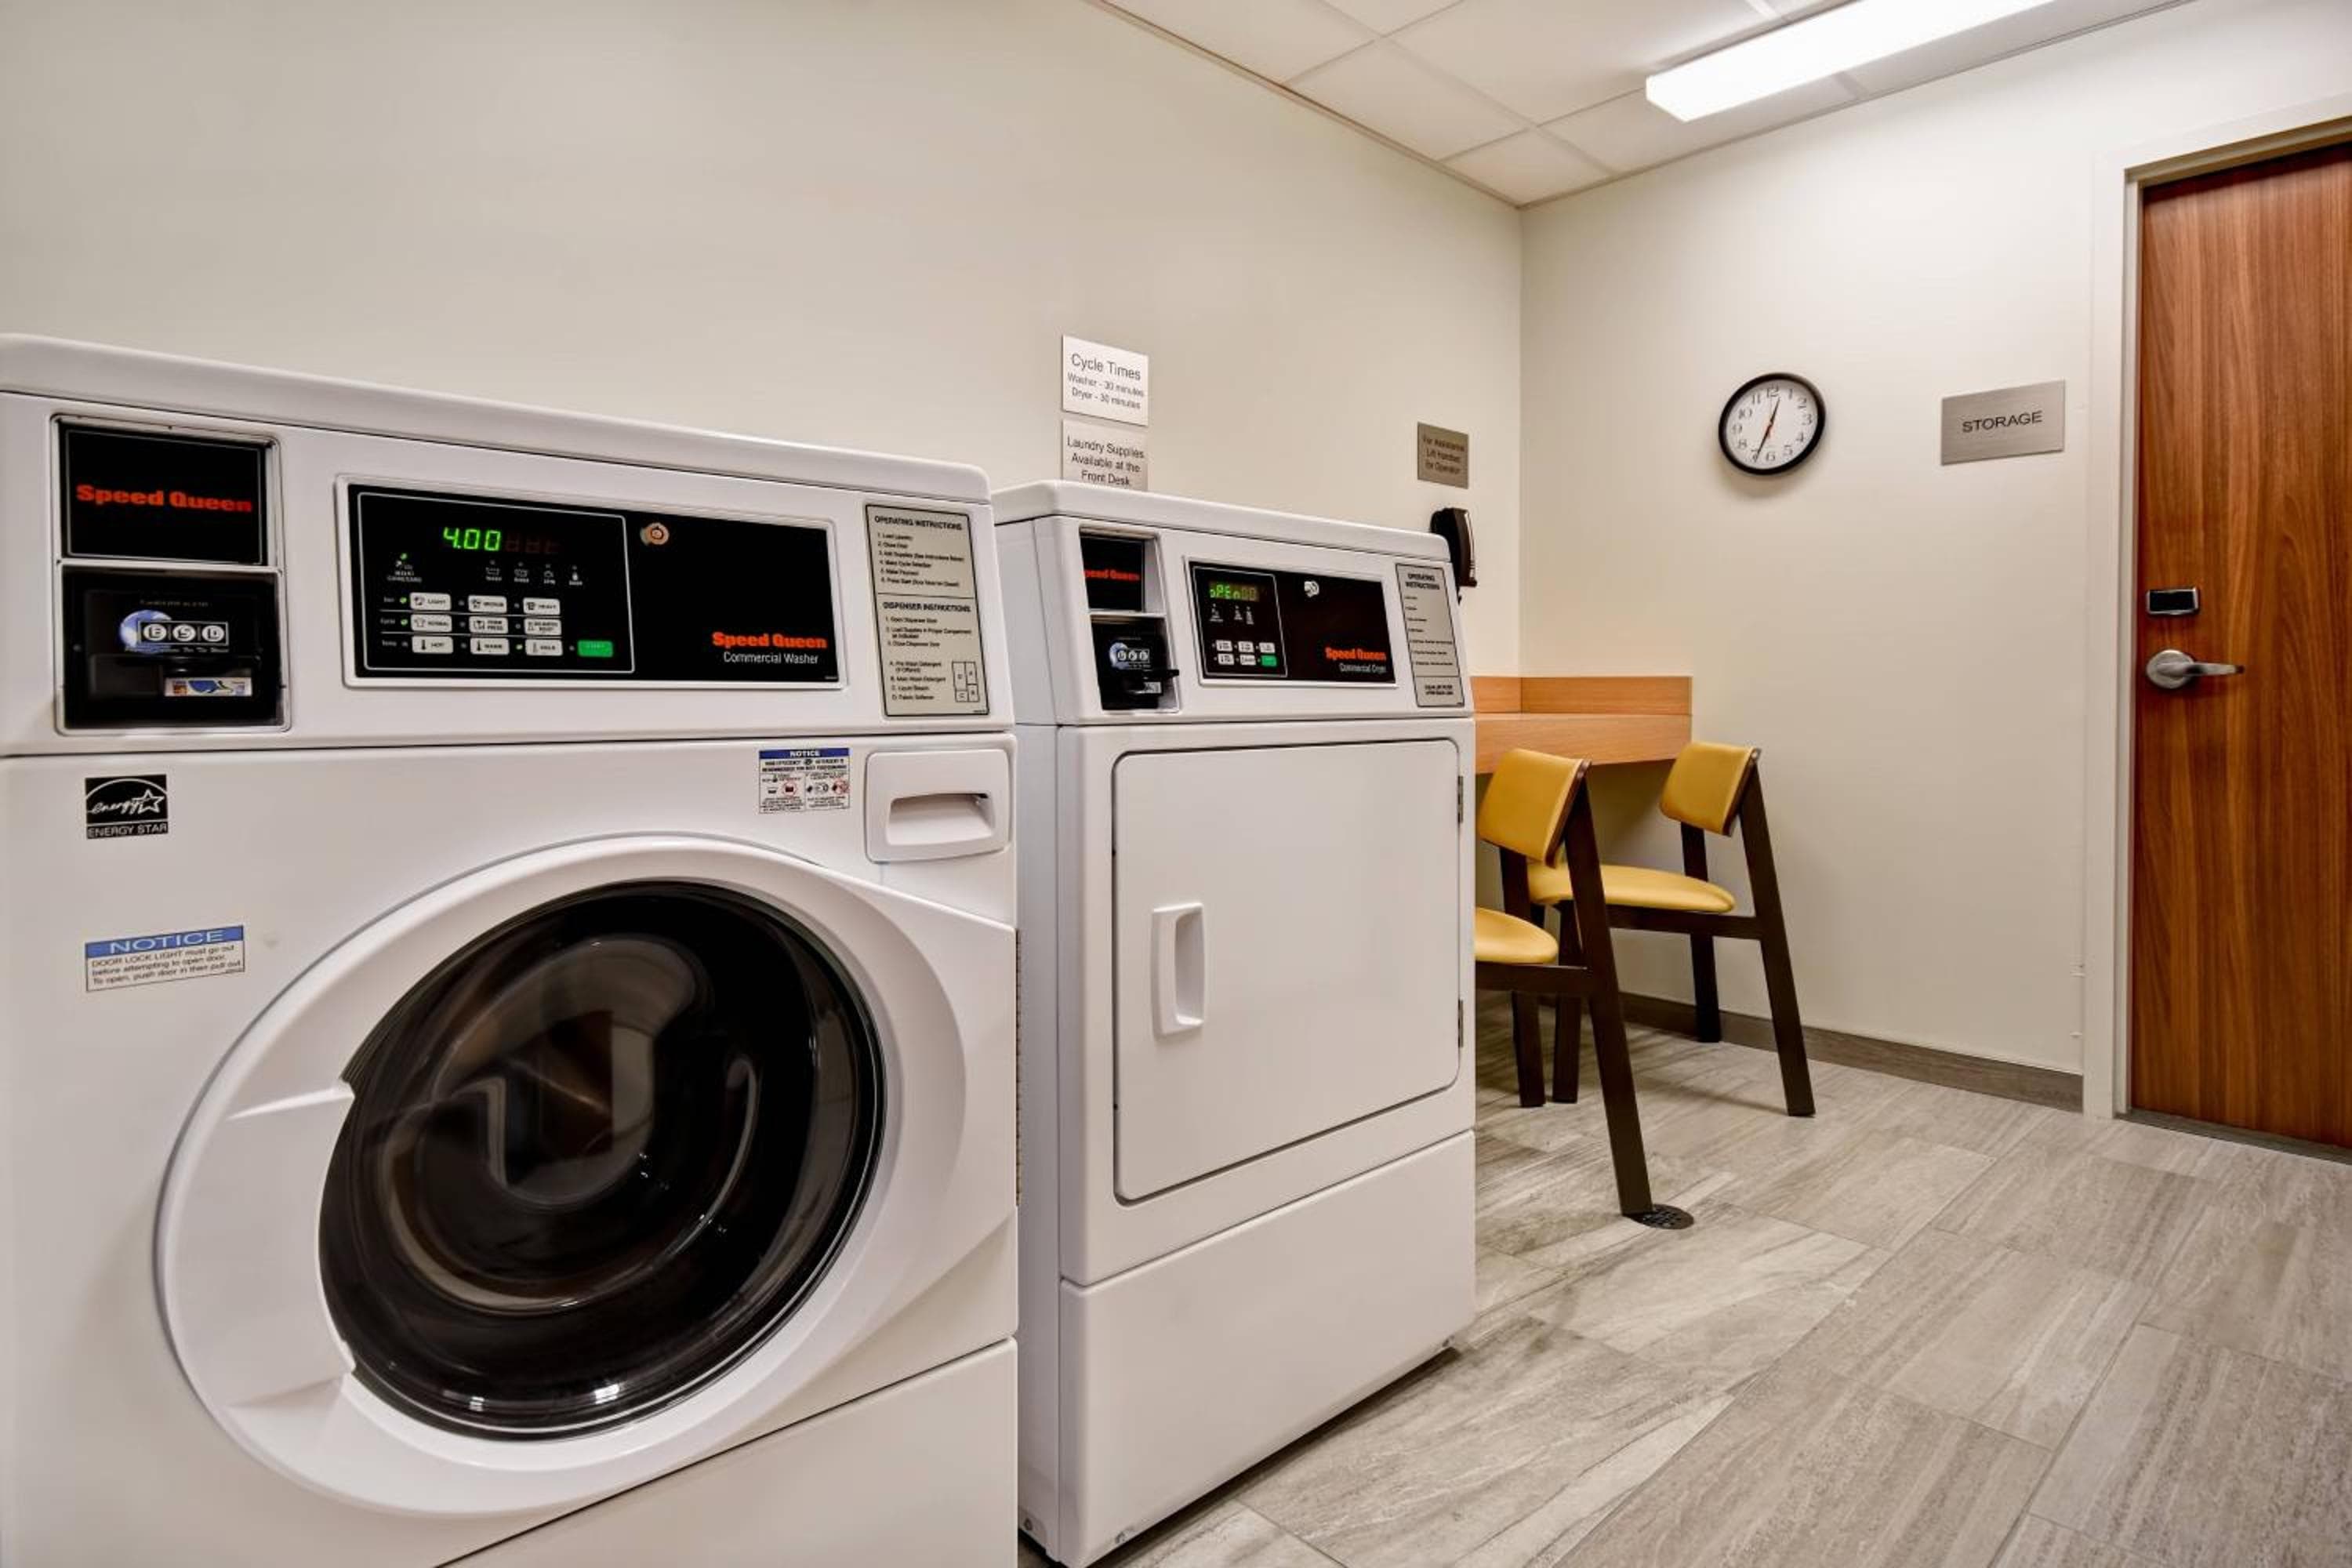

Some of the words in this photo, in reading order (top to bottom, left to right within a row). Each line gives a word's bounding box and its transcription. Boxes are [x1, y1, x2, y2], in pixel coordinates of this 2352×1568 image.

[1070, 353, 1103, 372] Cycle
[1107, 361, 1141, 381] Times
[1068, 372, 1097, 387] Washer
[1105, 381, 1114, 390] 30
[1116, 384, 1145, 397] minutes
[1766, 386, 1780, 398] 12
[1072, 387, 1093, 401] Dryer
[1100, 393, 1109, 404] 30
[1111, 396, 1141, 409] minutes
[1751, 393, 1761, 405] 11
[1962, 410, 2043, 434] STORAGE
[1067, 435, 1105, 454] Laundry
[1106, 442, 1145, 459] Supplies
[1071, 452, 1112, 469] Available
[1116, 460, 1123, 470] at
[1126, 460, 1141, 473] the
[1081, 470, 1106, 483] Front
[1108, 473, 1131, 485] Desk
[77, 484, 164, 506] Speed
[169, 491, 252, 512] Queen
[874, 515, 914, 526] OPERATING
[915, 520, 962, 531] INSTRUCTIONS
[443, 526, 500, 551] 4.00
[1109, 569, 1140, 581] Queen
[883, 601, 922, 611] DISPENSER
[923, 603, 971, 613] INSTRUCTIONS
[712, 630, 770, 649] Speed
[772, 633, 828, 649] Queen
[724, 652, 781, 665] Commercial
[783, 653, 819, 665] Washer
[1325, 647, 1356, 661] Speed
[1357, 647, 1386, 662] Queen
[1339, 662, 1371, 673] Commercial
[87, 825, 135, 838] ENERGY
[137, 822, 168, 835] STAR
[111, 930, 226, 954] NOTICE
[92, 957, 122, 968] DOOR
[125, 953, 151, 964] LOCK
[154, 949, 182, 960] LIGHT
[185, 946, 206, 956] must
[208, 946, 220, 955] go
[92, 967, 121, 977] before
[124, 960, 170, 974] attempting
[182, 956, 204, 967] open
[132, 970, 156, 982] push
[158, 967, 176, 976] door
